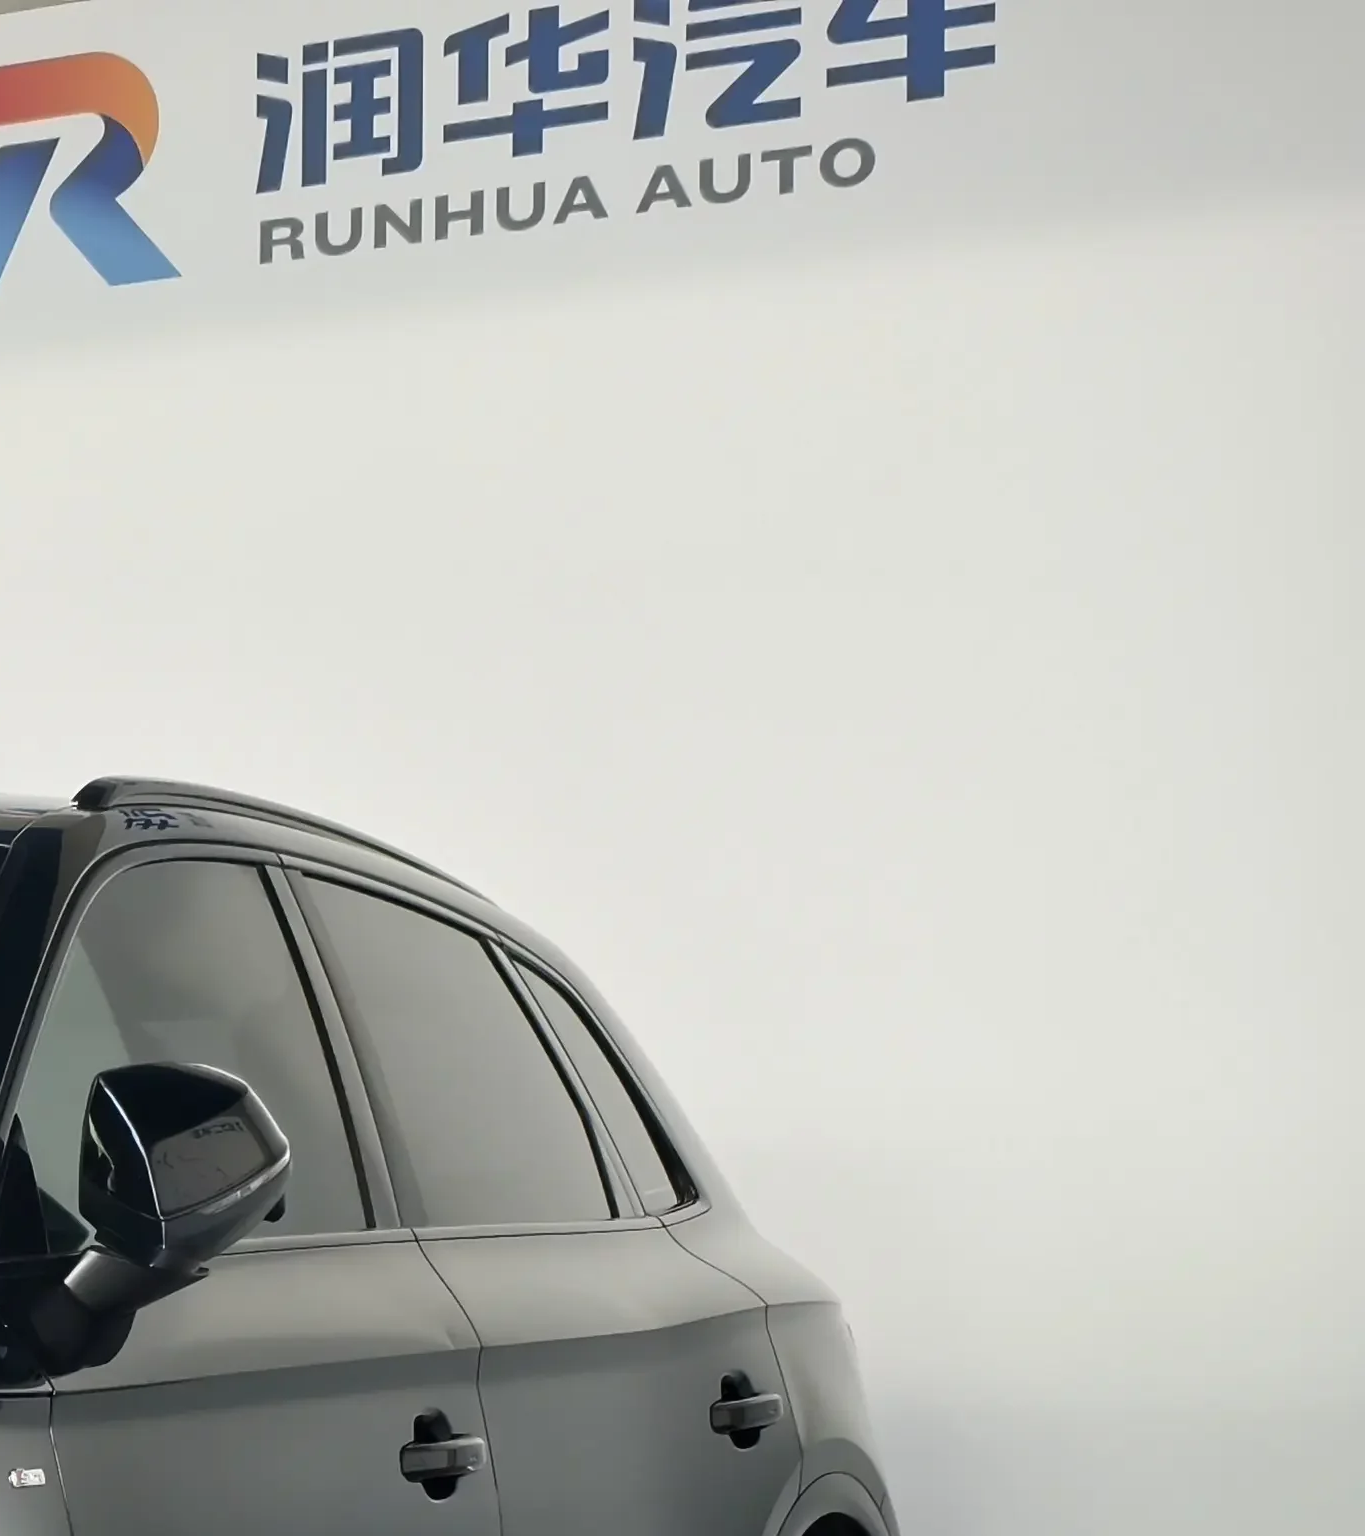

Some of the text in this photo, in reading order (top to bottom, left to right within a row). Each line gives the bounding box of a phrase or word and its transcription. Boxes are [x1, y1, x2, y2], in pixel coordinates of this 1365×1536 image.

[255, 0, 996, 195] 润华汽车
[259, 137, 876, 265] RUNHUA AUTO
